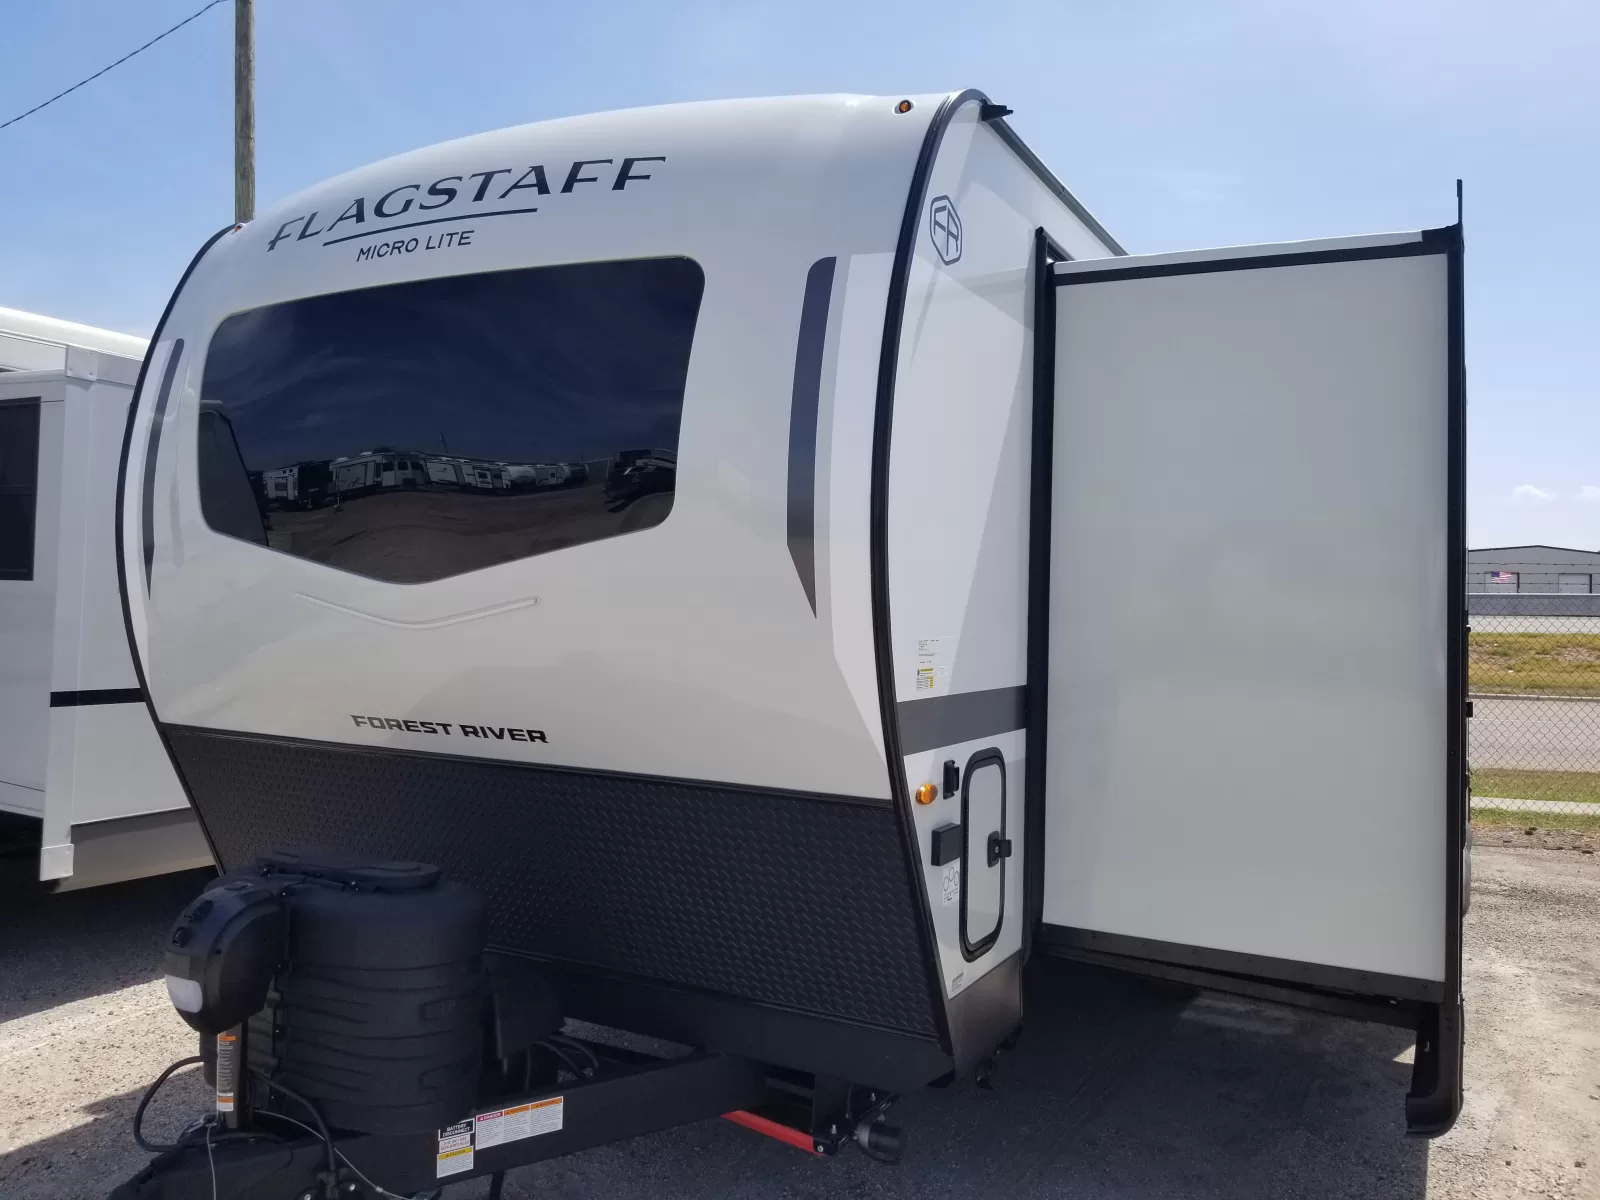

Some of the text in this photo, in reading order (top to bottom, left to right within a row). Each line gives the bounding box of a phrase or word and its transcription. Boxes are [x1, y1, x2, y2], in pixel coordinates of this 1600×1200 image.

[267, 156, 666, 252] FLAGSTAFF
[356, 230, 475, 262] MICRO LITE
[350, 714, 549, 744] FOREST RIVER
[442, 1126, 471, 1137] DISCONNECT
[446, 1123, 467, 1132] BATTERY
